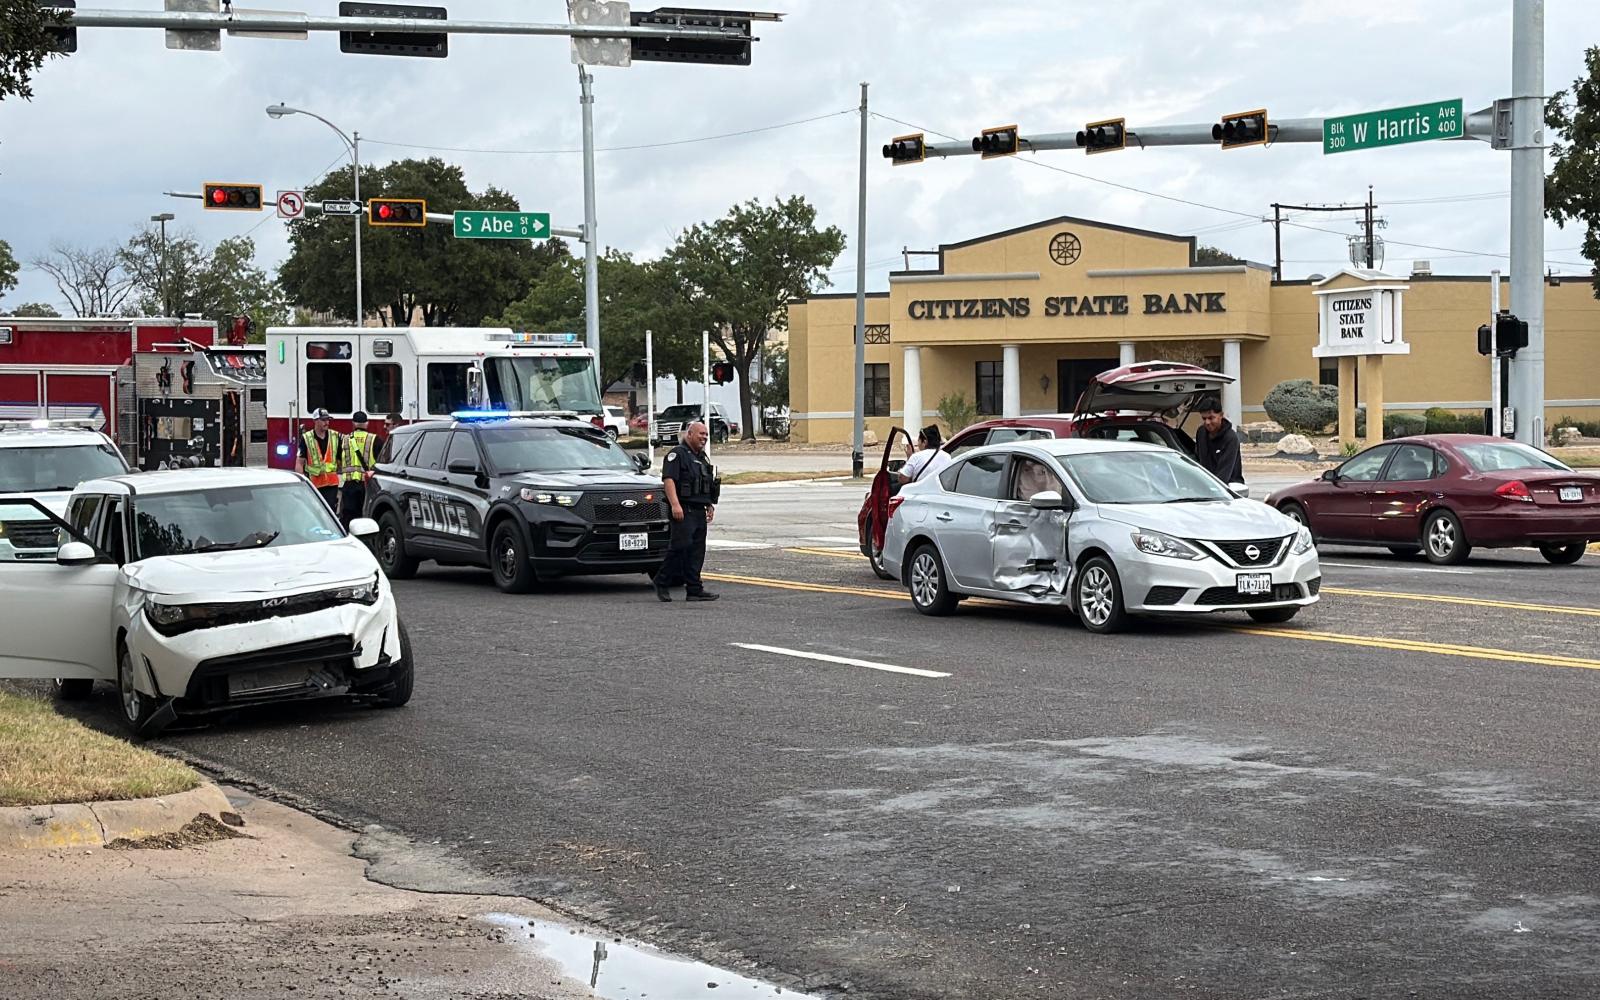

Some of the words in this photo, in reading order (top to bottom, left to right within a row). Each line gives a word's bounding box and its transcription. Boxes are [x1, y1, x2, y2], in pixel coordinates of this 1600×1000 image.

[1329, 136, 1346, 149] 300
[1438, 120, 1456, 133] 400
[1331, 122, 1345, 135] Blk
[1353, 121, 1368, 143] W
[1377, 112, 1430, 140] Harris
[1438, 106, 1456, 119] Ave
[462, 216, 473, 232] S
[480, 216, 514, 233] Abe
[520, 216, 528, 225] St
[908, 297, 1030, 320] CITIZENS
[1044, 295, 1128, 317] STATE
[1142, 292, 1226, 315] BANK
[1332, 298, 1373, 312] CITIZENS
[1339, 313, 1365, 325] STATE
[1341, 327, 1364, 339] BANK
[409, 498, 470, 537] POLICE
